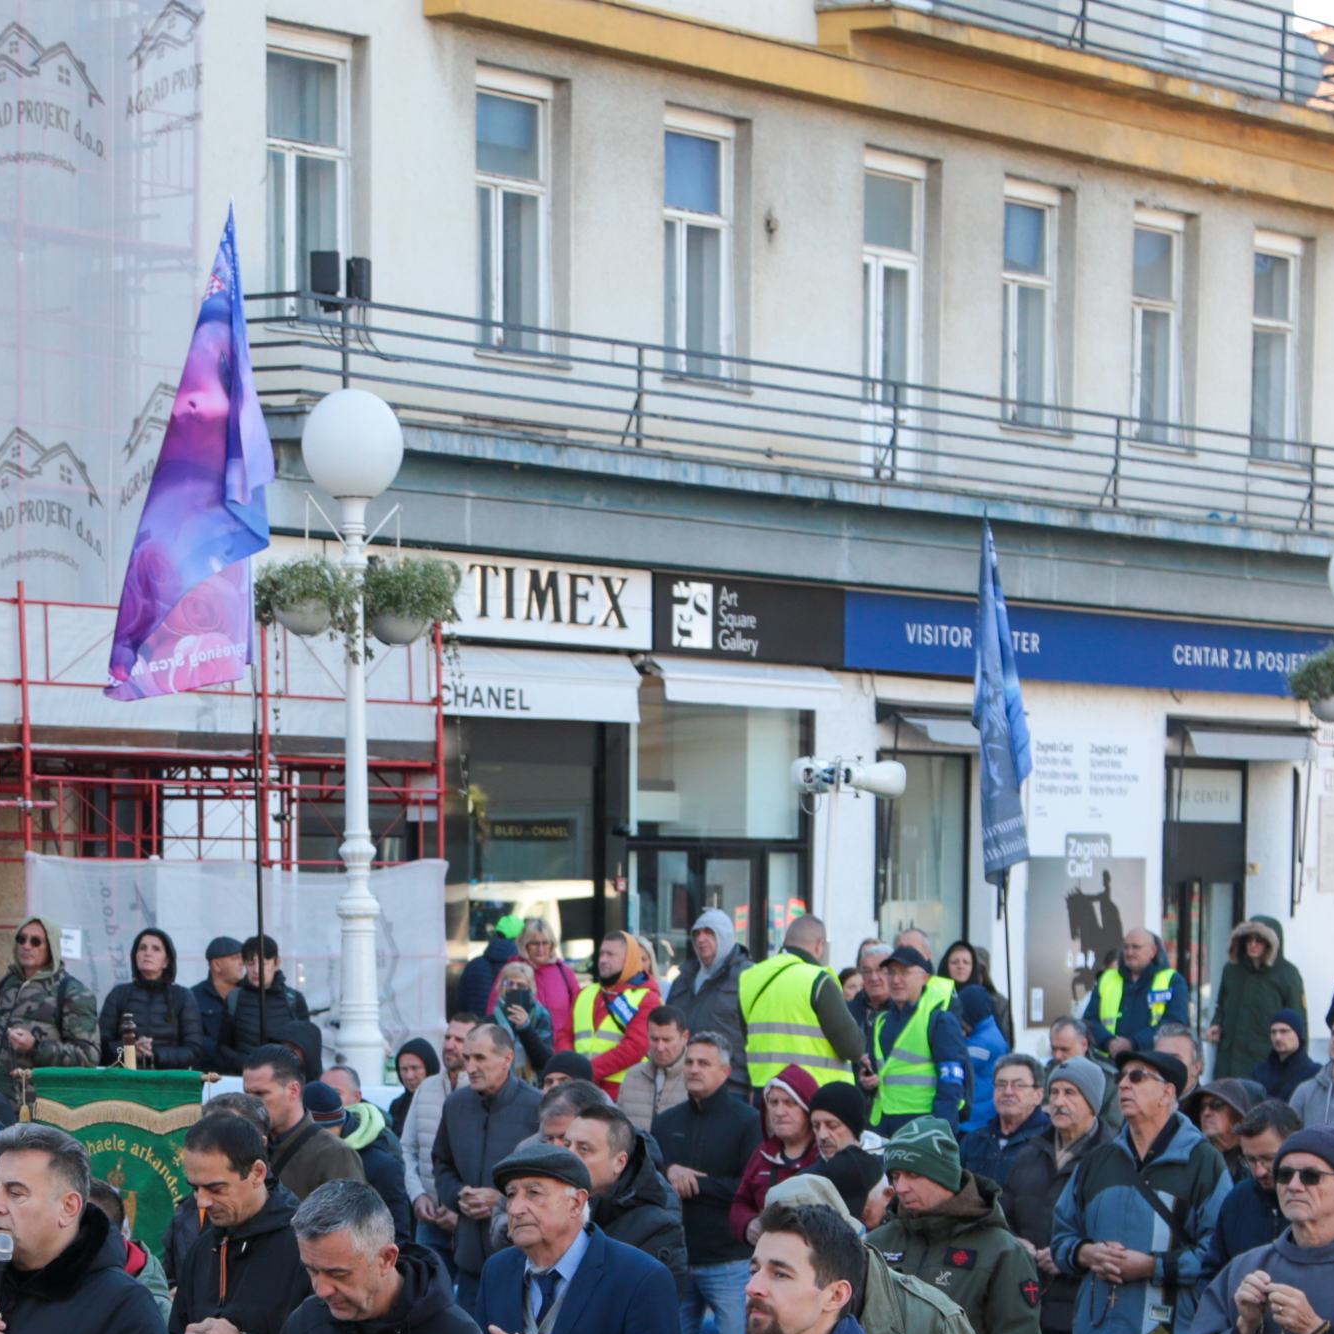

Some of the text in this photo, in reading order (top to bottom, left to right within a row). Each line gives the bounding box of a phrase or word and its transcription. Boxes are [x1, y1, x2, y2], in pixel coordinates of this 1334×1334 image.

[173, 63, 203, 94] PROJE
[18, 100, 71, 132] PROJEKT
[74, 119, 107, 160] d.o.o.
[19, 500, 73, 530] PROJEKT
[76, 517, 106, 561] d.o.o.
[445, 560, 629, 629] TIMEX
[719, 585, 739, 607] Art
[718, 605, 757, 632] Square
[717, 629, 759, 657] Gallery
[905, 622, 1041, 654] VISITOR TER
[1173, 644, 1308, 673] CENTAR ZA POSJET
[440, 683, 531, 711] CHANEL
[1193, 791, 1231, 804] CENTER
[494, 825, 524, 836] BLEU
[531, 826, 570, 837] CHANEL
[1068, 839, 1109, 861] Zagreb
[1068, 860, 1093, 877] Card
[85, 1133, 127, 1156] haele
